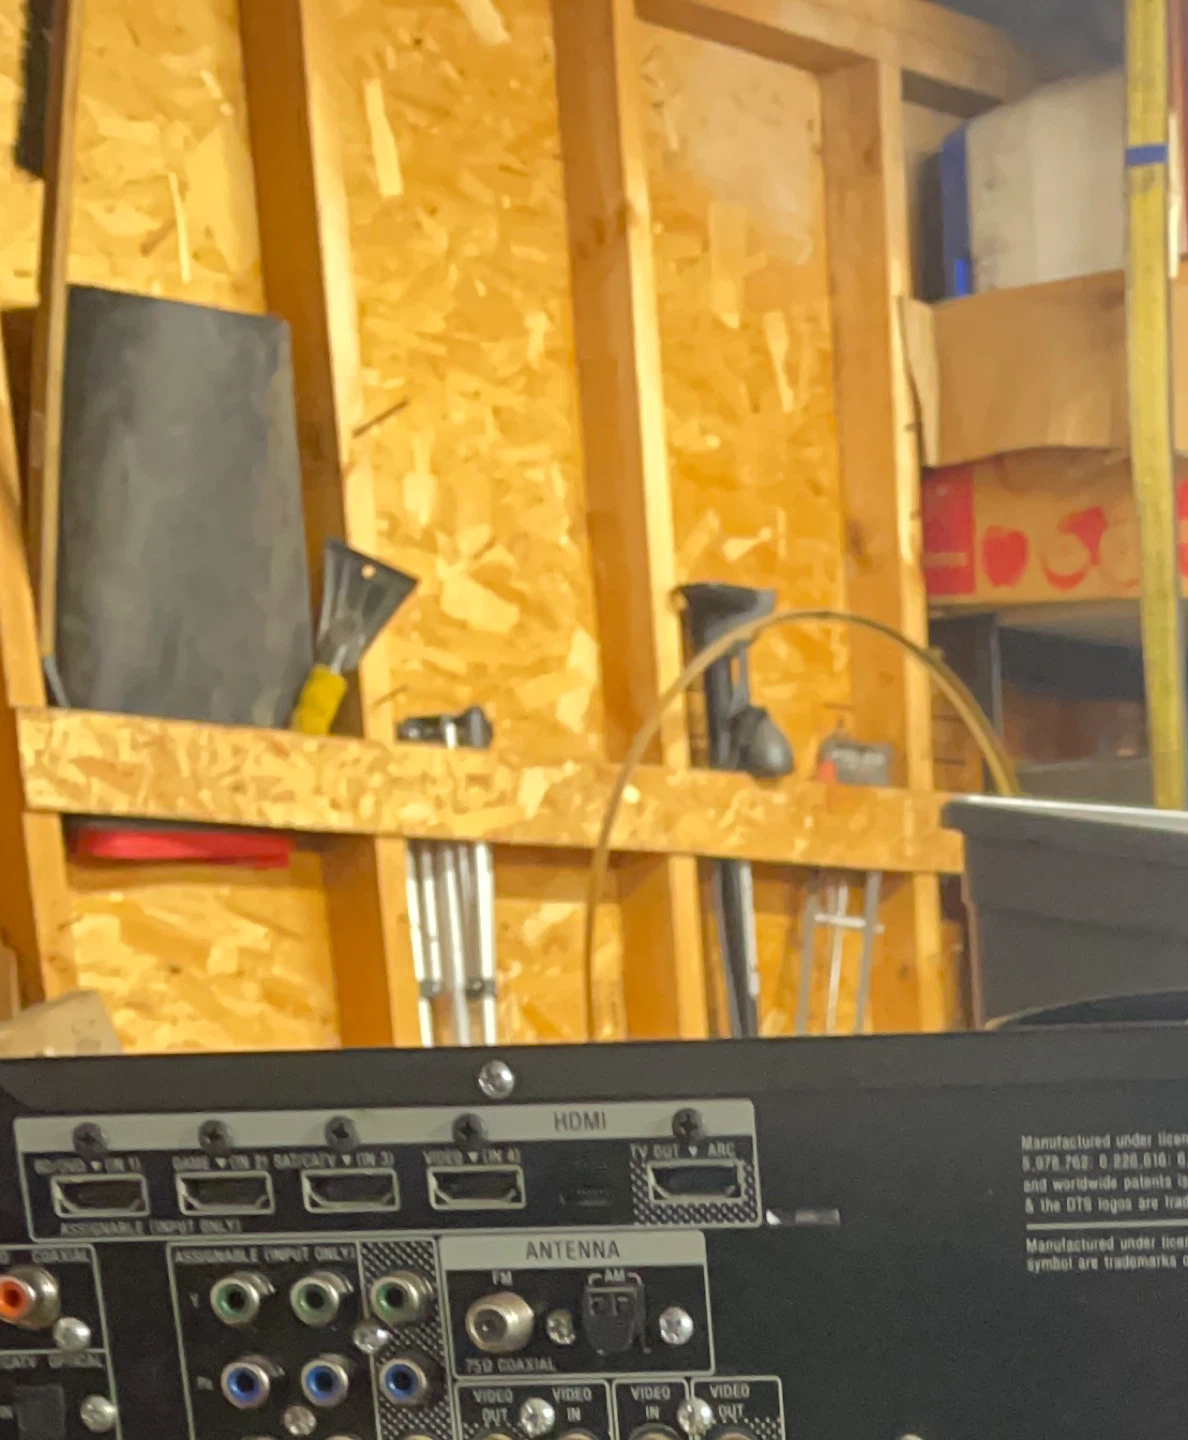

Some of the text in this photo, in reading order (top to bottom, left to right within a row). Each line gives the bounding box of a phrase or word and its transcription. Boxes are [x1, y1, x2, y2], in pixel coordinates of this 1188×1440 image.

[553, 1110, 607, 1131] HDMI
[1021, 1134, 1111, 1150] Manufactured
[1115, 1133, 1151, 1148] under
[423, 1149, 462, 1166] VIDEO
[630, 1142, 735, 1160] TV OUT ARC
[1023, 1178, 1047, 1193] and
[1052, 1176, 1117, 1192] worldwide
[1124, 1174, 1172, 1192] patents
[1040, 1197, 1061, 1213] the
[1066, 1195, 1092, 1213] DTS
[1098, 1196, 1132, 1214] logos
[1138, 1196, 1158, 1211] are
[525, 1240, 621, 1261] ANTENNA
[1026, 1235, 1114, 1252] Manufactured
[1120, 1235, 1155, 1250] under
[1026, 1256, 1073, 1275] symbol
[1078, 1257, 1098, 1271] are
[1104, 1252, 1177, 1271] trademarks
[603, 1268, 625, 1283] AM
[498, 1358, 557, 1373] COAXIAL
[473, 1389, 513, 1404] VIDEO
[552, 1387, 592, 1402] VIDEO
[630, 1386, 671, 1401] VIDEO
[709, 1384, 750, 1399] VIDEO
[482, 1408, 508, 1424] OUT
[567, 1406, 581, 1422] IN
[645, 1405, 660, 1420] IN
[718, 1403, 744, 1419] OUT
